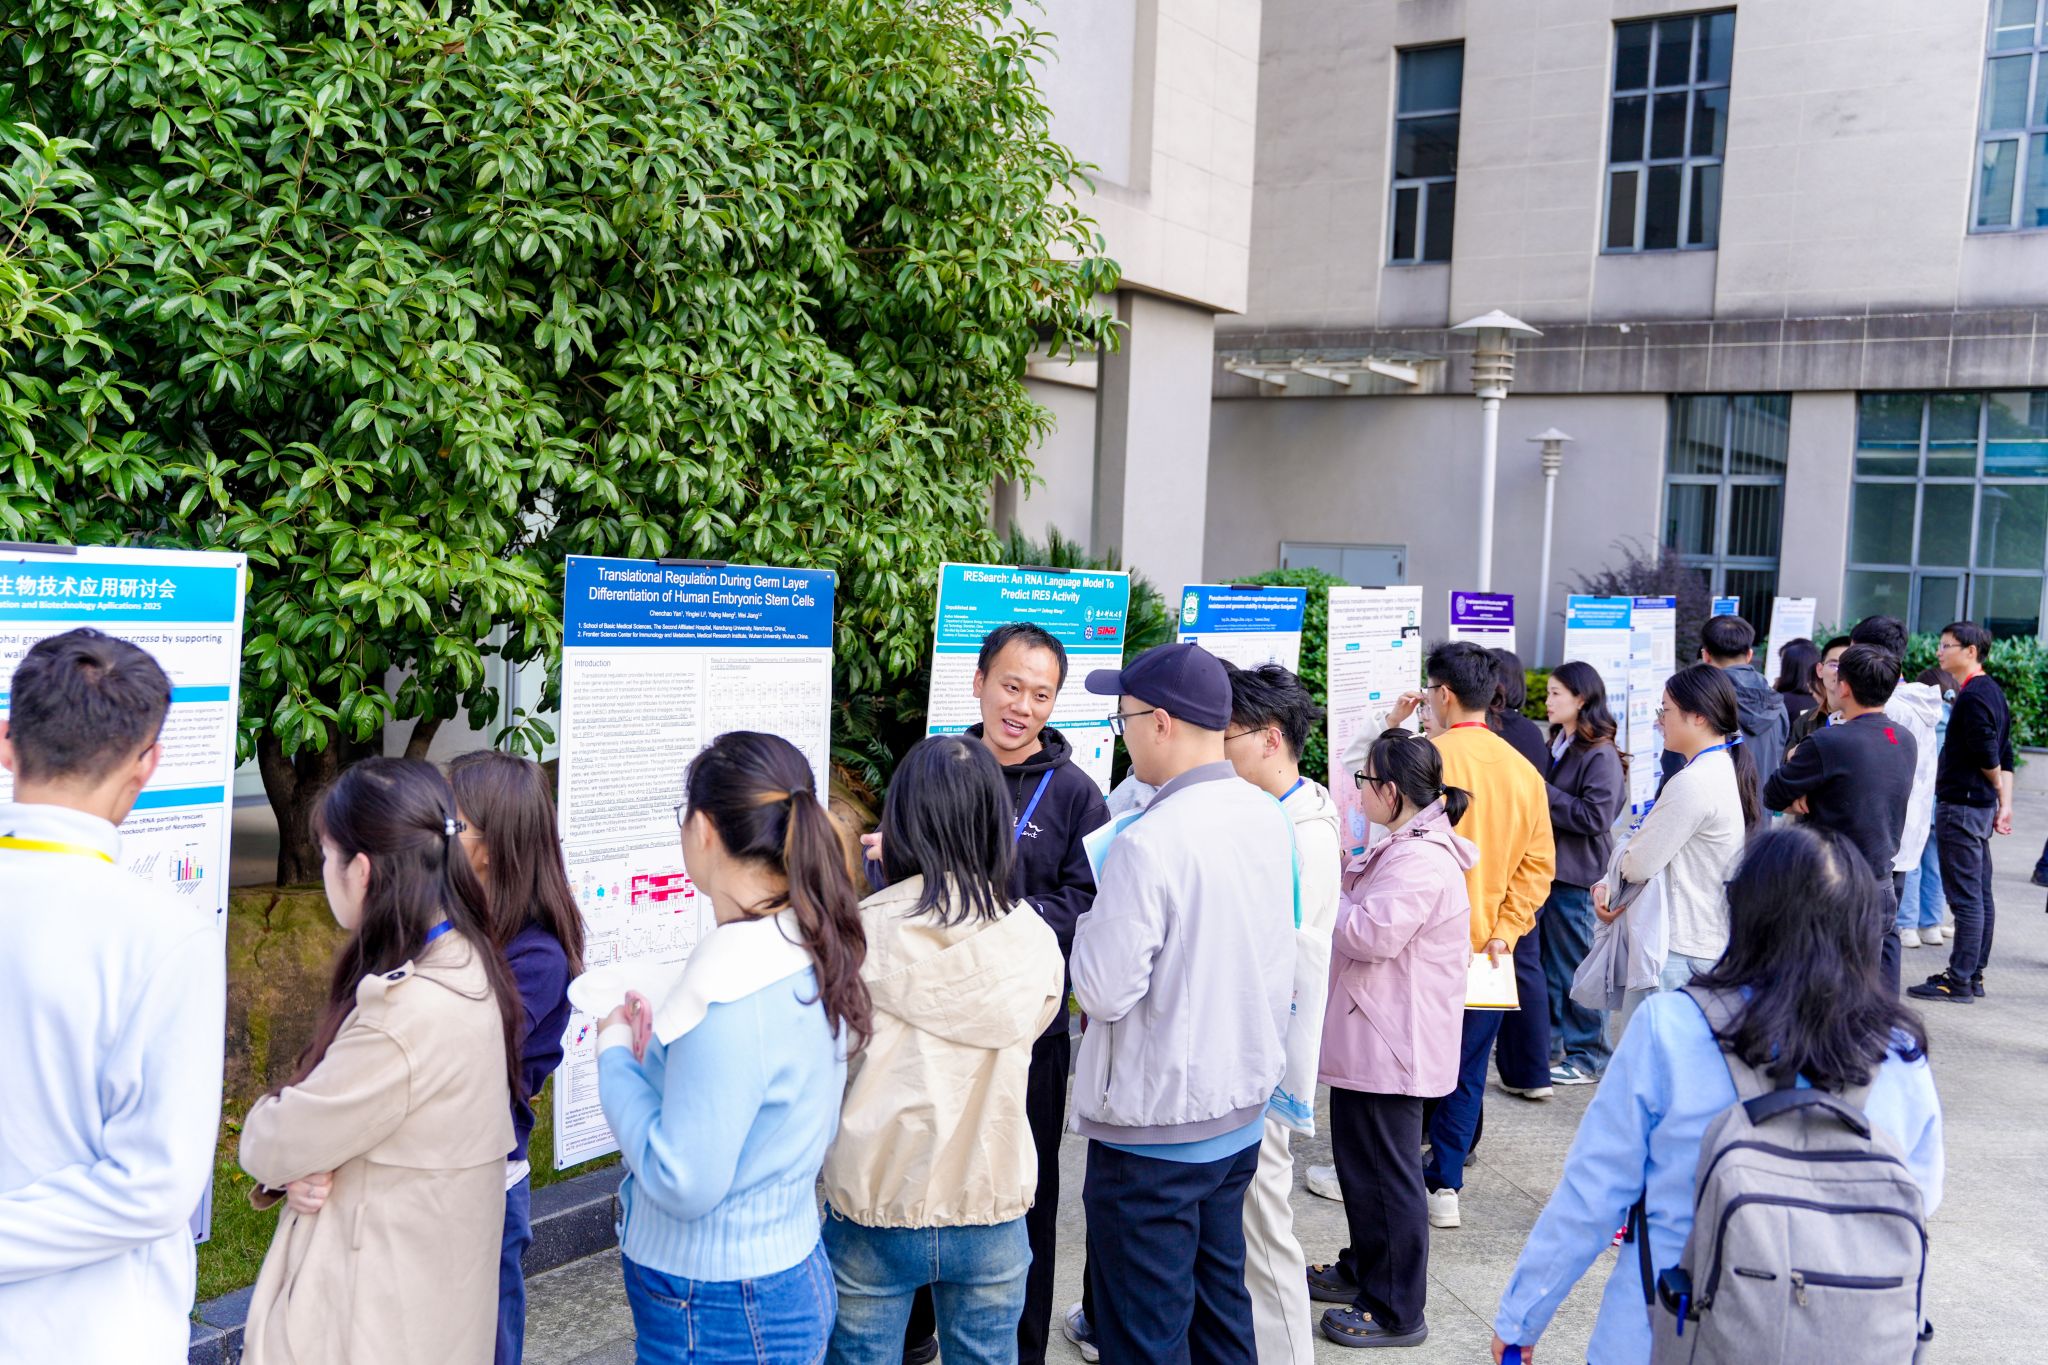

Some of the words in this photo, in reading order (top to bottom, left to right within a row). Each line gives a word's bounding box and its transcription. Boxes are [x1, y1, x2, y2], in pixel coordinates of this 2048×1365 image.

[0, 574, 177, 599] 生物技术应用研讨会
[598, 568, 662, 583] Translational
[666, 570, 716, 587] Regulation
[720, 573, 752, 590] During
[754, 575, 780, 588] Germ
[782, 576, 808, 592] Layer
[964, 570, 1009, 584] IRESearch:
[1011, 574, 1022, 584] An
[1024, 574, 1042, 585] RNA
[1045, 576, 1081, 589] Language
[1083, 578, 1104, 588] Model
[1106, 579, 1114, 588] To
[589, 586, 660, 602] Differentiation
[662, 590, 672, 602] of
[674, 590, 710, 604] Human
[712, 592, 762, 608] Embryonic
[765, 593, 789, 606] Stem
[792, 594, 814, 606] Cells
[1001, 588, 1030, 600] Predict
[1032, 590, 1050, 600] IRES
[1052, 591, 1080, 604] Activity
[162, 634, 172, 643] by
[176, 634, 222, 644] supporting
[574, 660, 611, 668] Introduction
